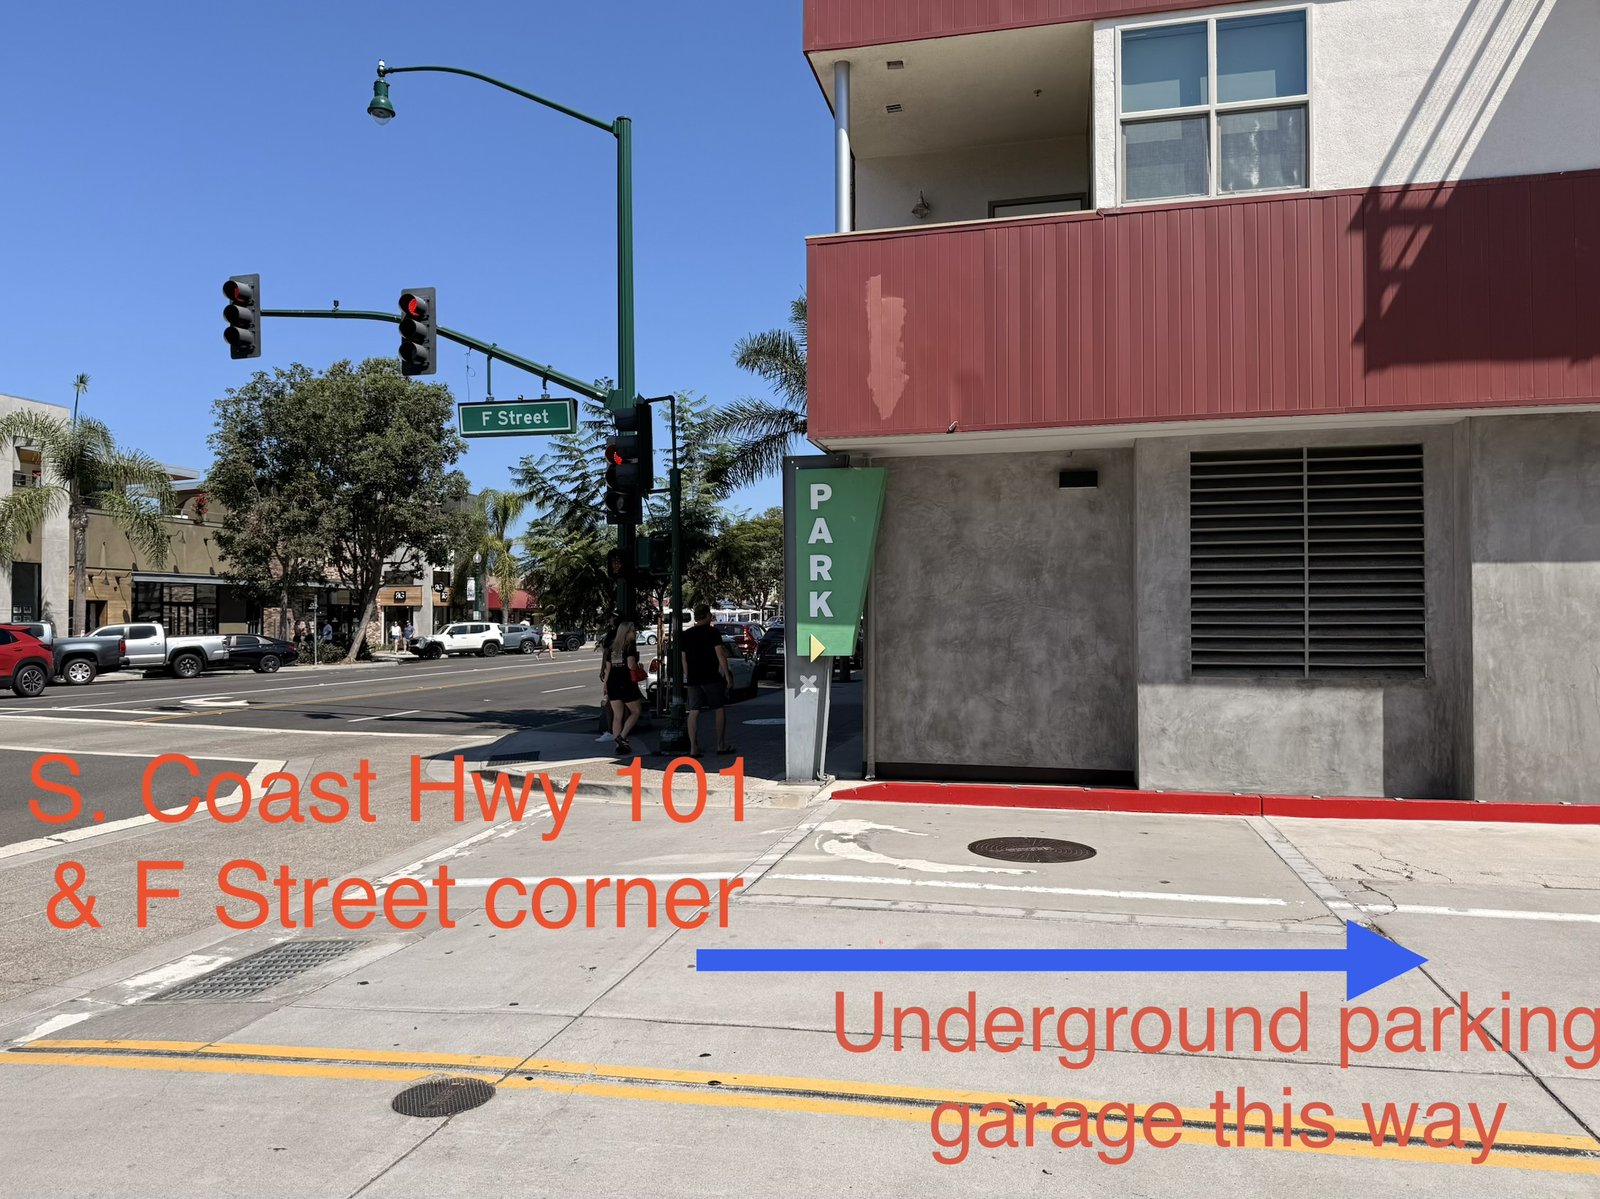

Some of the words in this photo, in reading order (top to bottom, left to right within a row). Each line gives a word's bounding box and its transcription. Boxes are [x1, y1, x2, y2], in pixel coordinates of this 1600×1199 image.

[482, 411, 492, 426] F
[498, 409, 549, 425] Street
[807, 483, 834, 618] PARK
